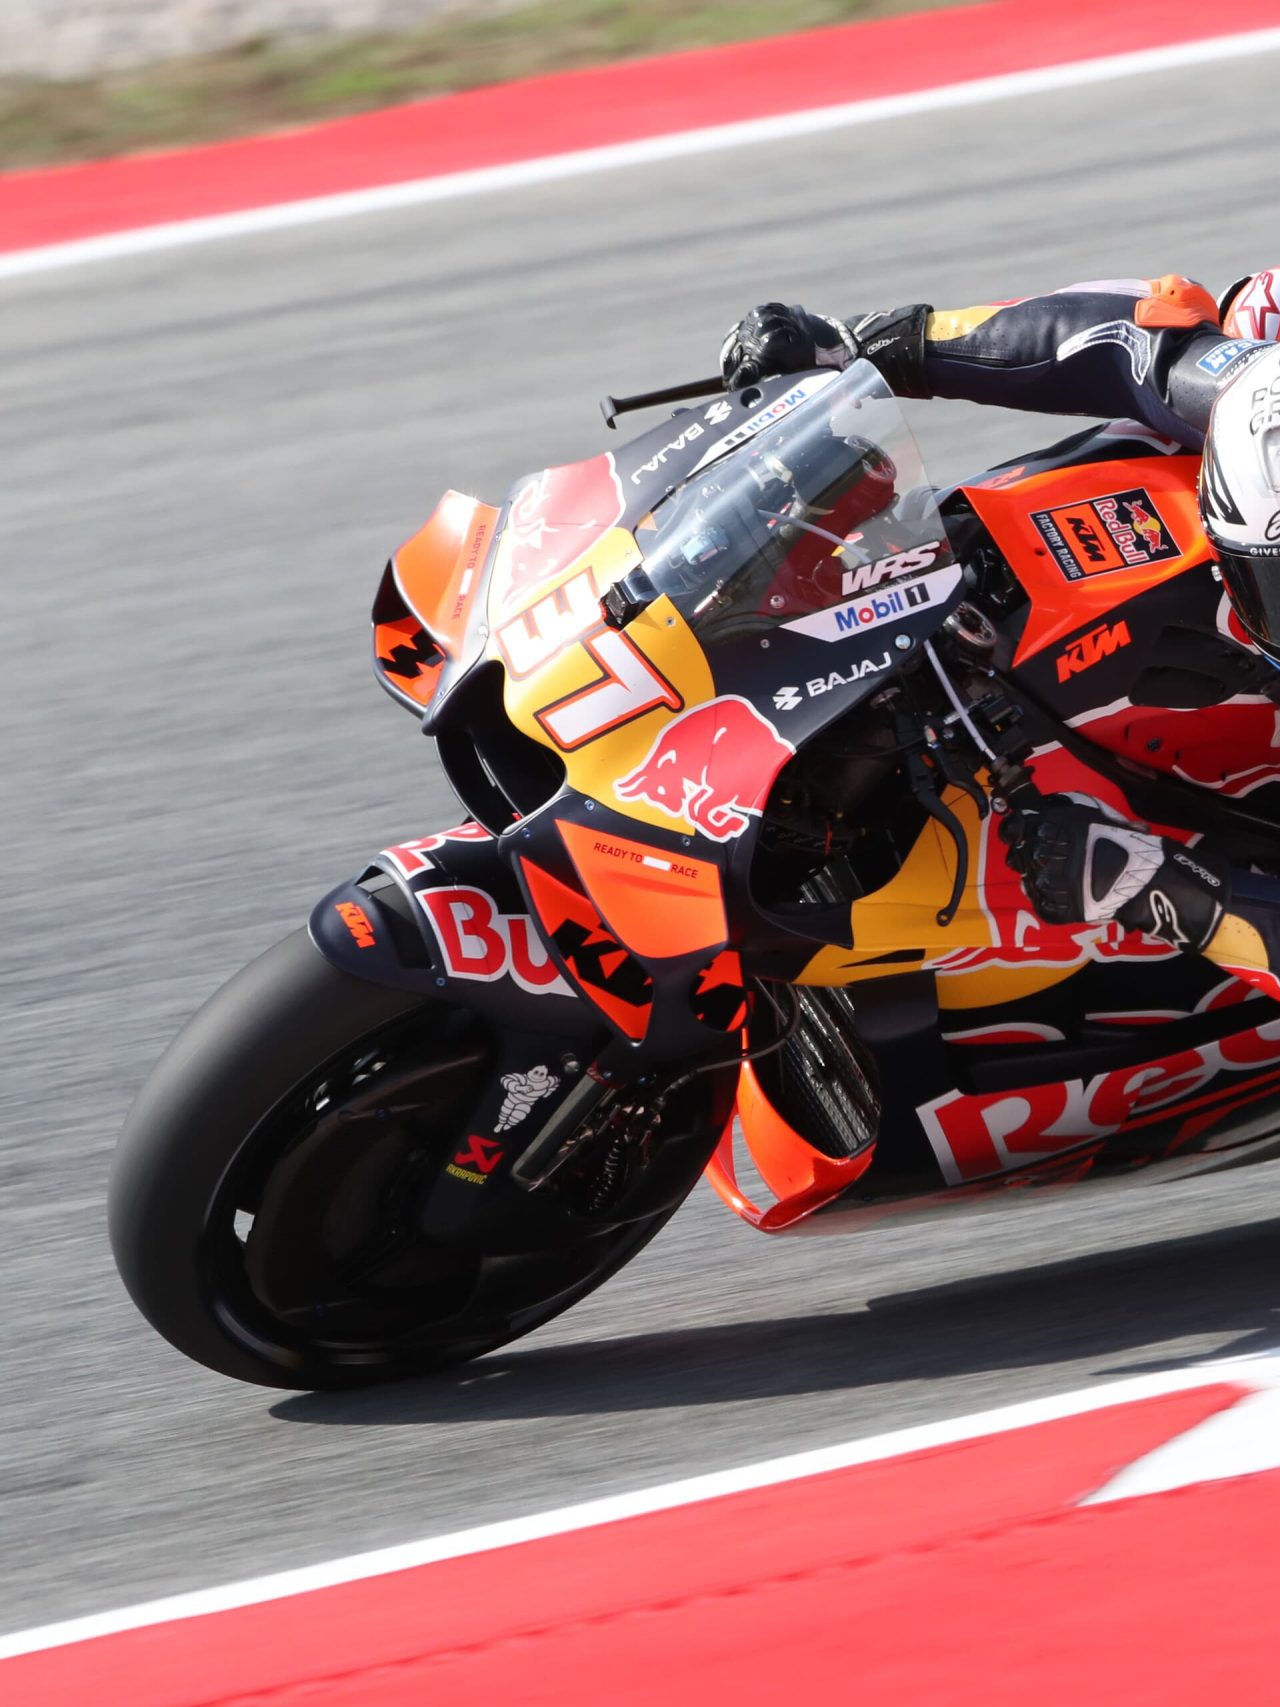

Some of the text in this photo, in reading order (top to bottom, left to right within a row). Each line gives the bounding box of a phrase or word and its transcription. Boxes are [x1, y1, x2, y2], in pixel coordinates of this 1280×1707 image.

[748, 389, 807, 433] Mobil
[630, 422, 704, 485] BAJAJ
[1035, 513, 1083, 579] FACTORY RACING
[1065, 517, 1107, 563] KTM
[841, 540, 941, 596] WRS
[834, 591, 904, 632] Mobil
[805, 651, 893, 698] BAJAJ
[1057, 620, 1131, 683] KTM
[593, 842, 643, 864] READY TO
[670, 863, 700, 879] RACE
[335, 902, 376, 948] KTM
[415, 885, 579, 998] Bu
